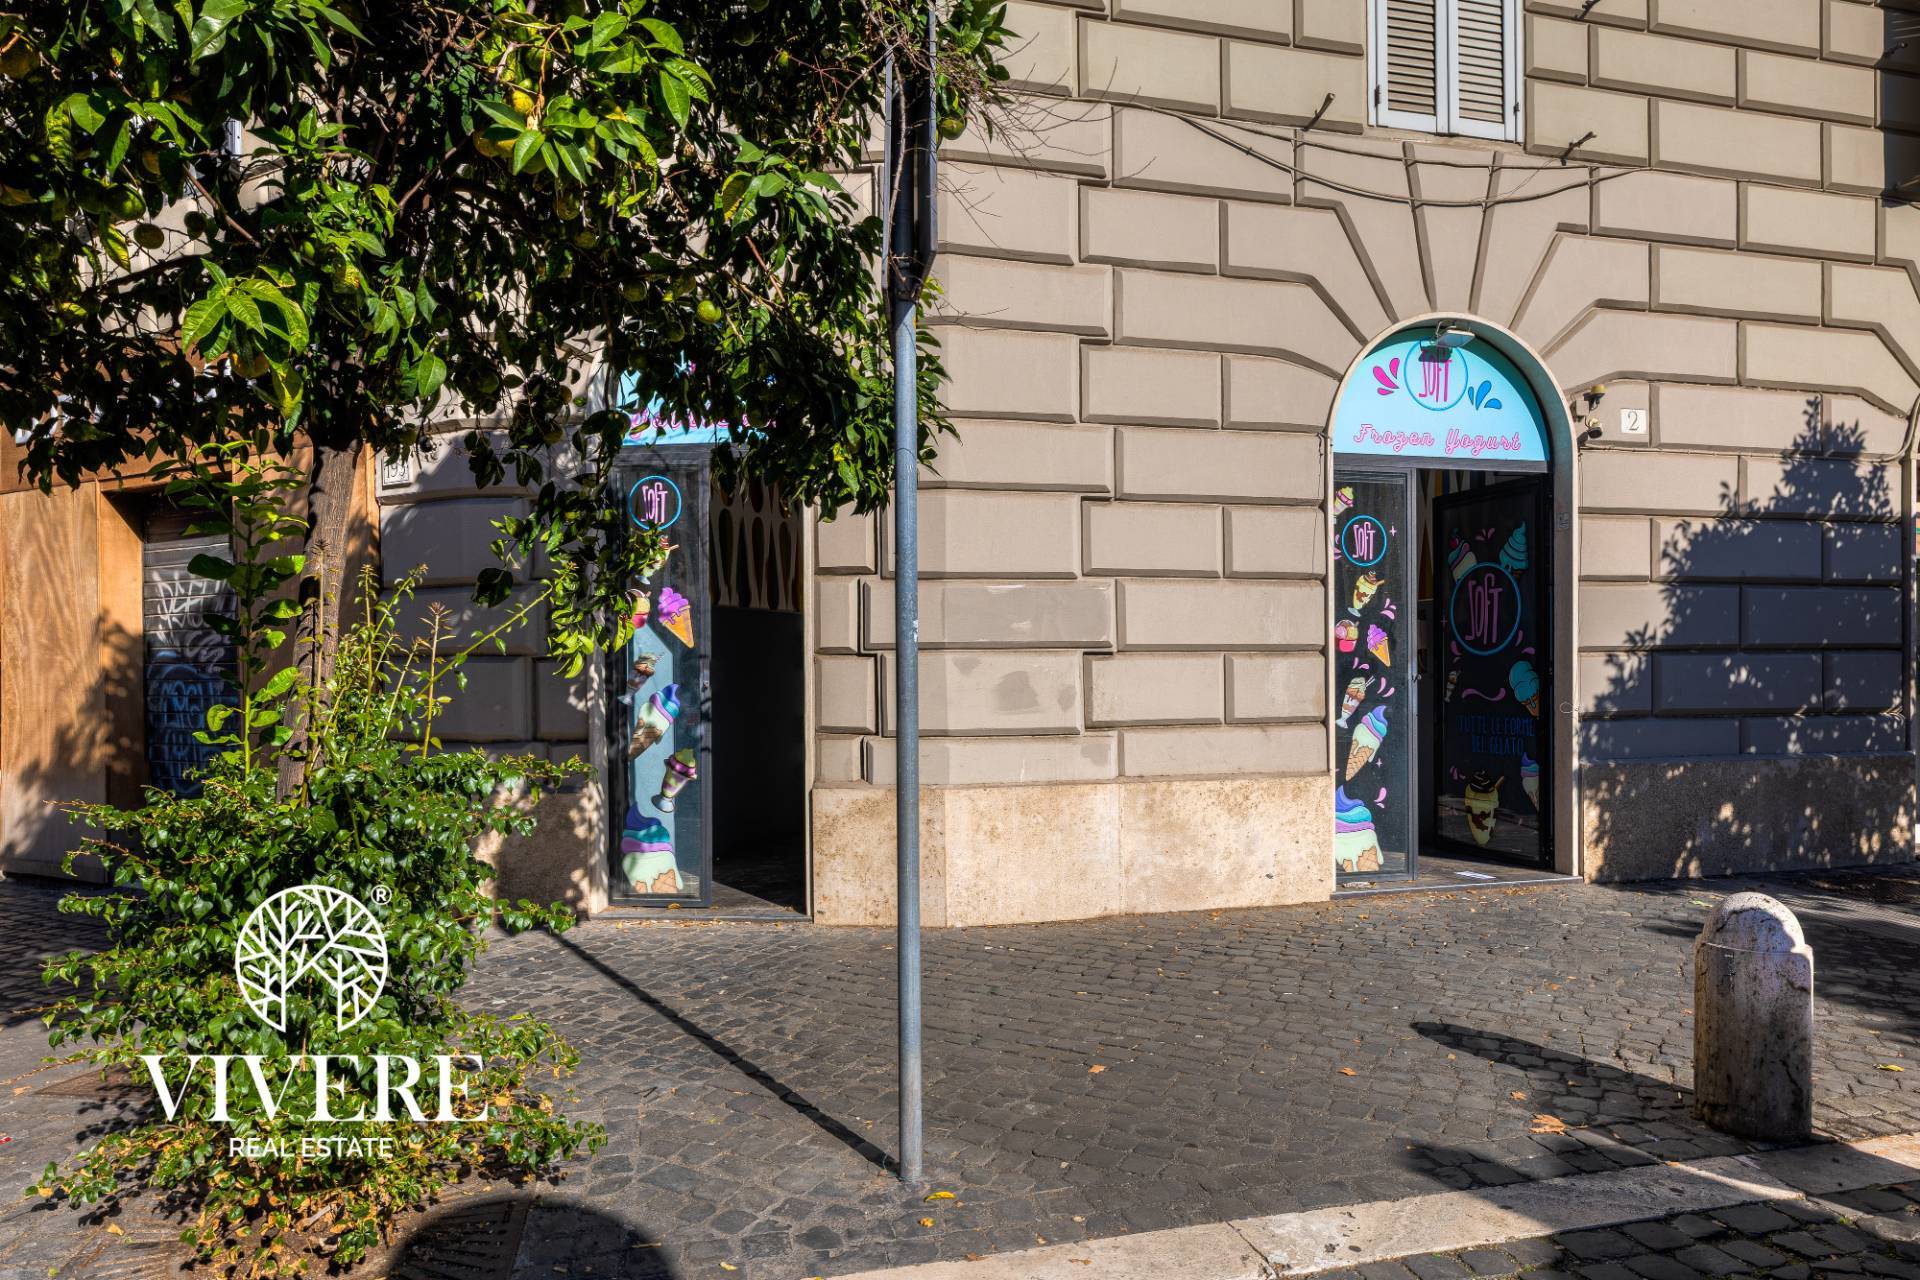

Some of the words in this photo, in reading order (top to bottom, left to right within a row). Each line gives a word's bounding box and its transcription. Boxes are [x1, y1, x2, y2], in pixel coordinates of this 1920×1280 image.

[1418, 345, 1453, 403] SOFT
[1627, 410, 1640, 431] 2
[1353, 423, 1435, 452] Frozen
[1444, 428, 1521, 456] Yogurt
[640, 481, 668, 524] SOFT
[1352, 521, 1376, 561] SOFT
[1464, 572, 1503, 645] SOFT
[1504, 715, 1535, 737] FORME
[1490, 736, 1525, 756] GELATO
